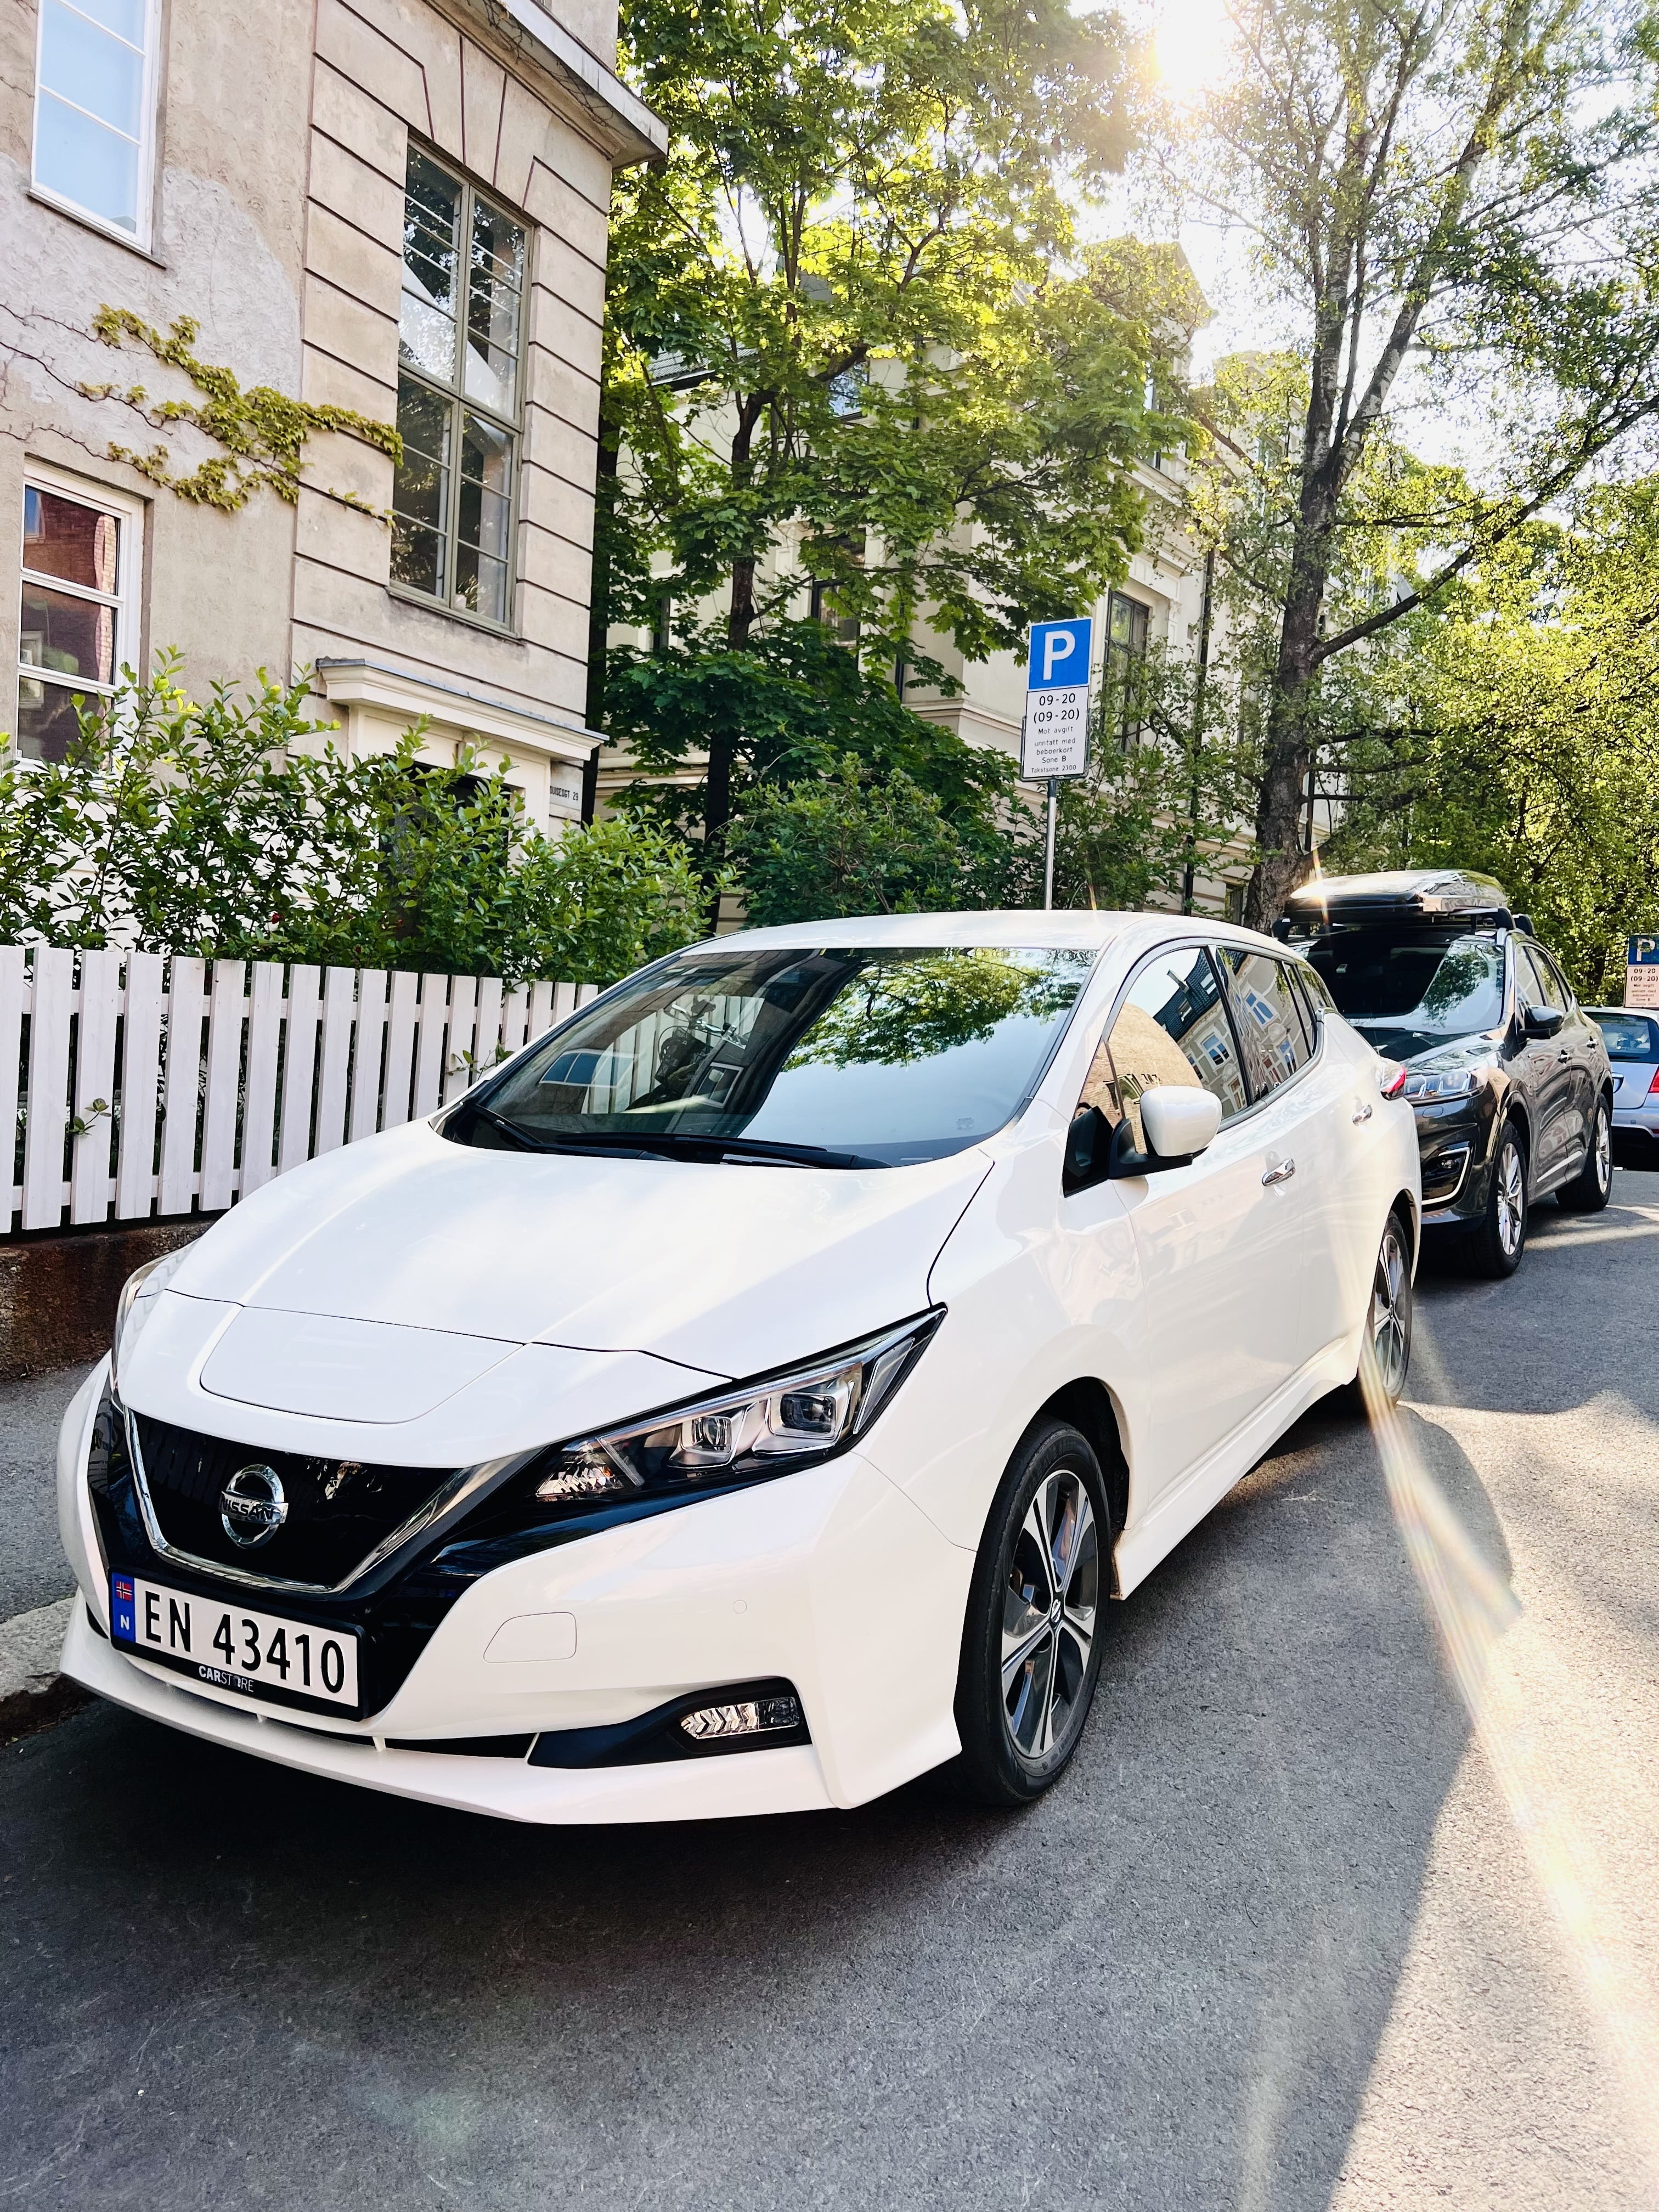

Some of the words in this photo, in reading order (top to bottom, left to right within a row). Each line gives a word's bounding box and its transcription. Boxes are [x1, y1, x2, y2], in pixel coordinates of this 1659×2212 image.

[1043, 630, 1076, 680] P
[1036, 747, 1073, 755] beboerkort
[1637, 938, 1656, 961] P
[219, 1494, 274, 1520] NISSAN
[120, 1615, 129, 1630] N
[145, 1590, 191, 1652] EN
[212, 1613, 345, 1694] 43410
